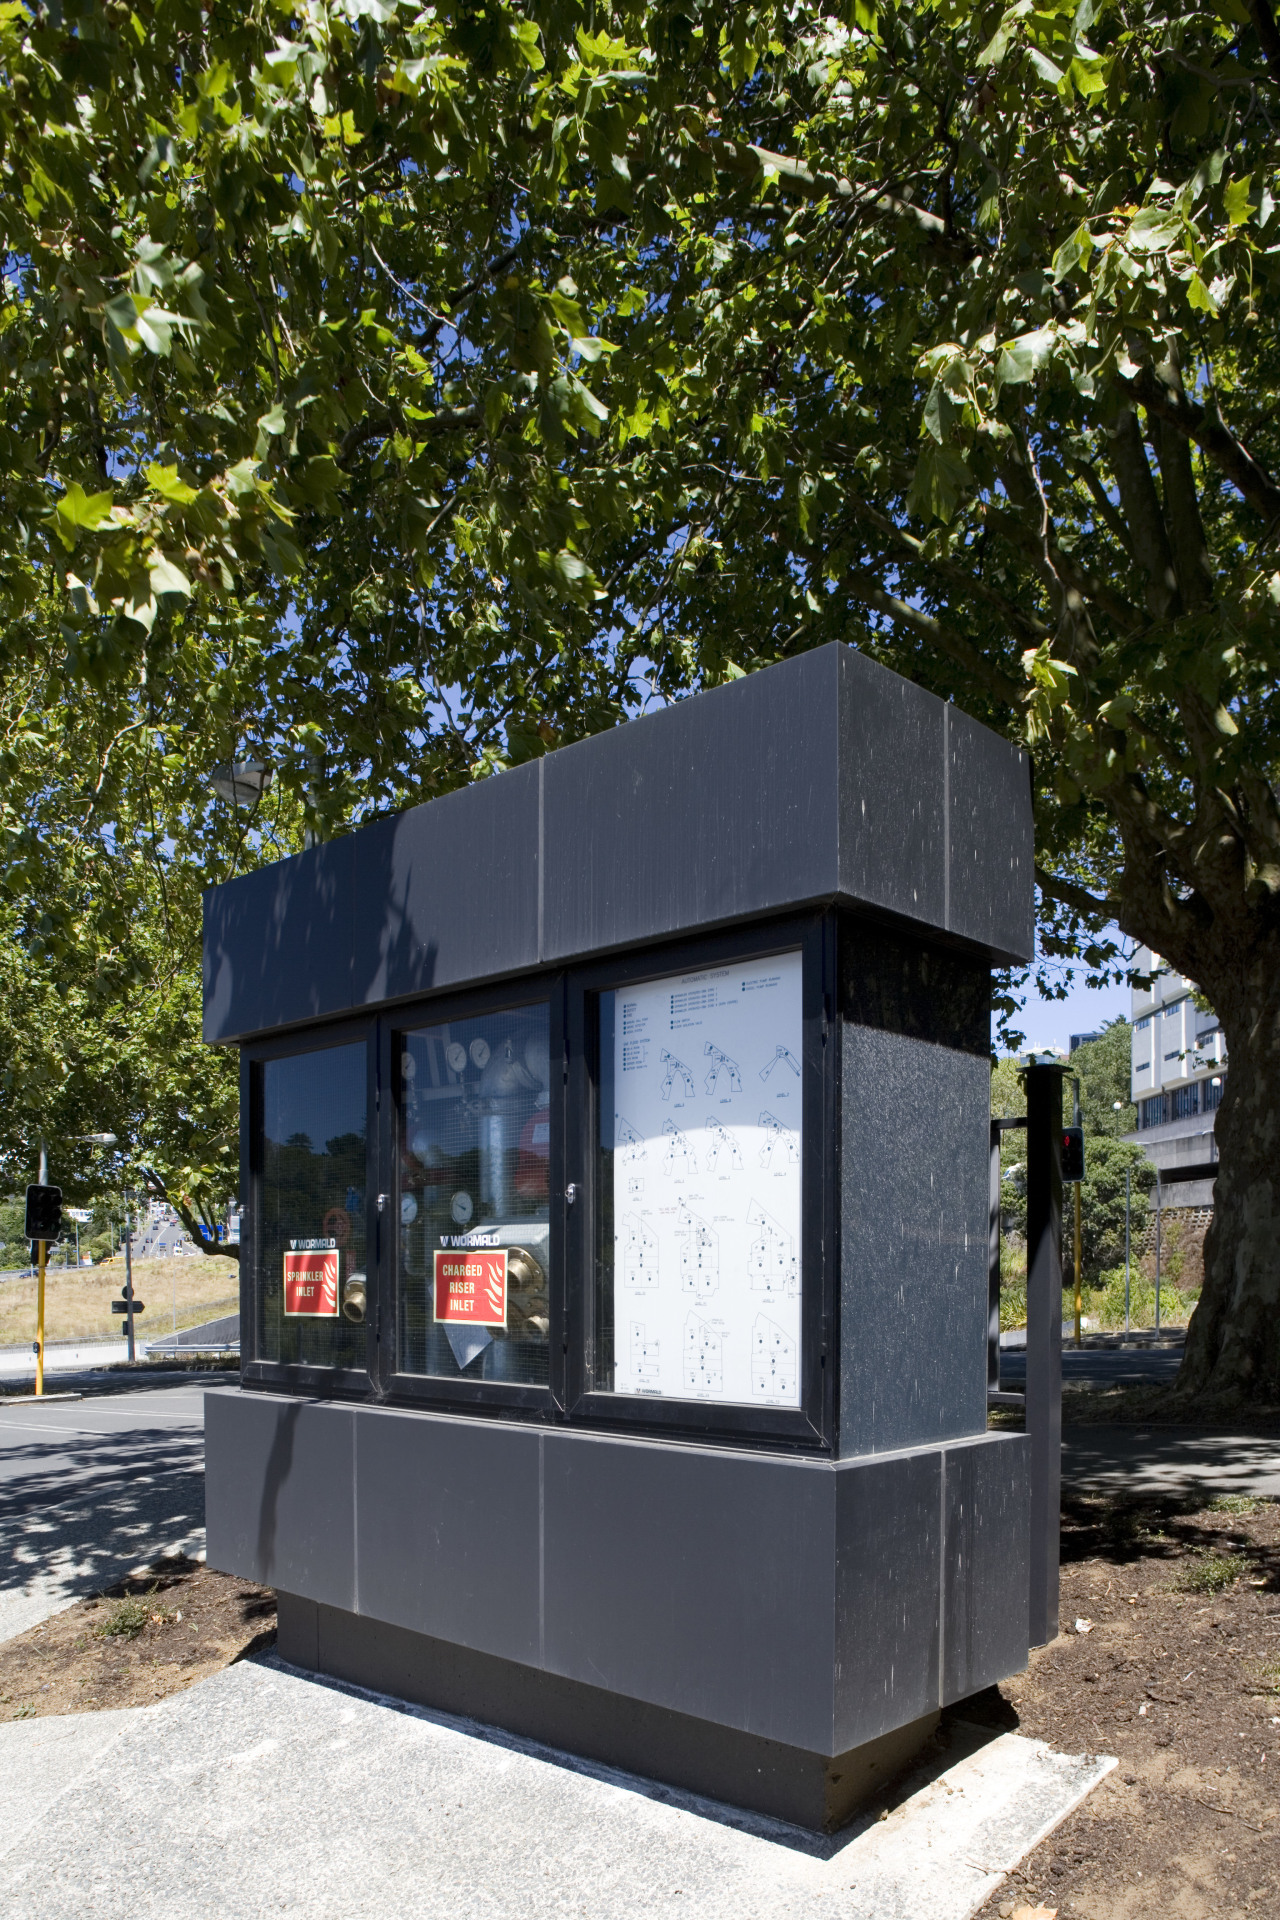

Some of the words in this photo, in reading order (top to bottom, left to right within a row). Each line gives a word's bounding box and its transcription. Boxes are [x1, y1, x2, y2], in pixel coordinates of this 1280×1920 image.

[681, 974, 708, 984] AUTOMATIC
[709, 969, 729, 979] SYSTEM
[298, 1238, 336, 1249] WORMALD
[450, 1234, 500, 1247] WORMALD
[287, 1271, 324, 1282] SPRINKLER
[442, 1264, 483, 1277] CHARGED
[296, 1286, 315, 1297] INLET
[449, 1281, 475, 1294] RISER
[450, 1299, 475, 1312] INLET
